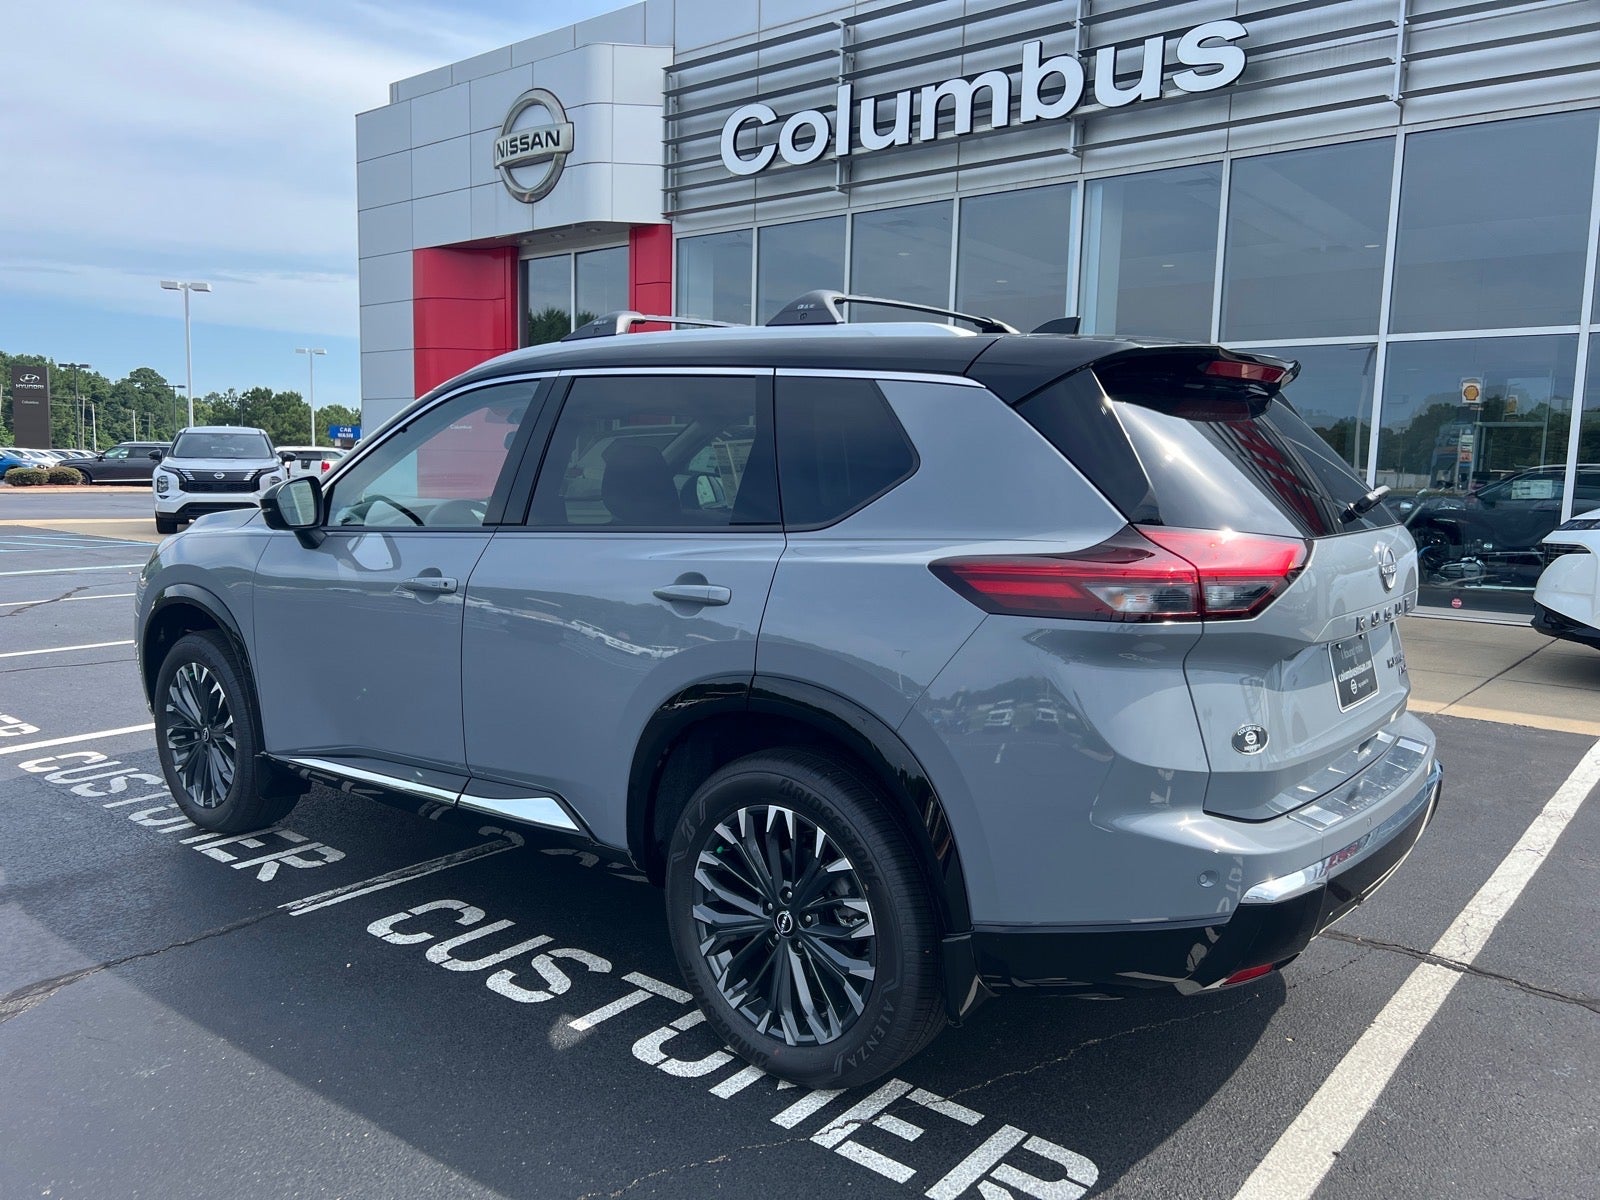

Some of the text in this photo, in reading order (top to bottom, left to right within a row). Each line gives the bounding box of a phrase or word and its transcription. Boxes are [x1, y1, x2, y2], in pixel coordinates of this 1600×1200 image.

[719, 19, 1249, 176] Columbus
[496, 129, 560, 159] NISSAN
[1356, 598, 1410, 633] ROGUE
[846, 998, 895, 1067] ALENZA
